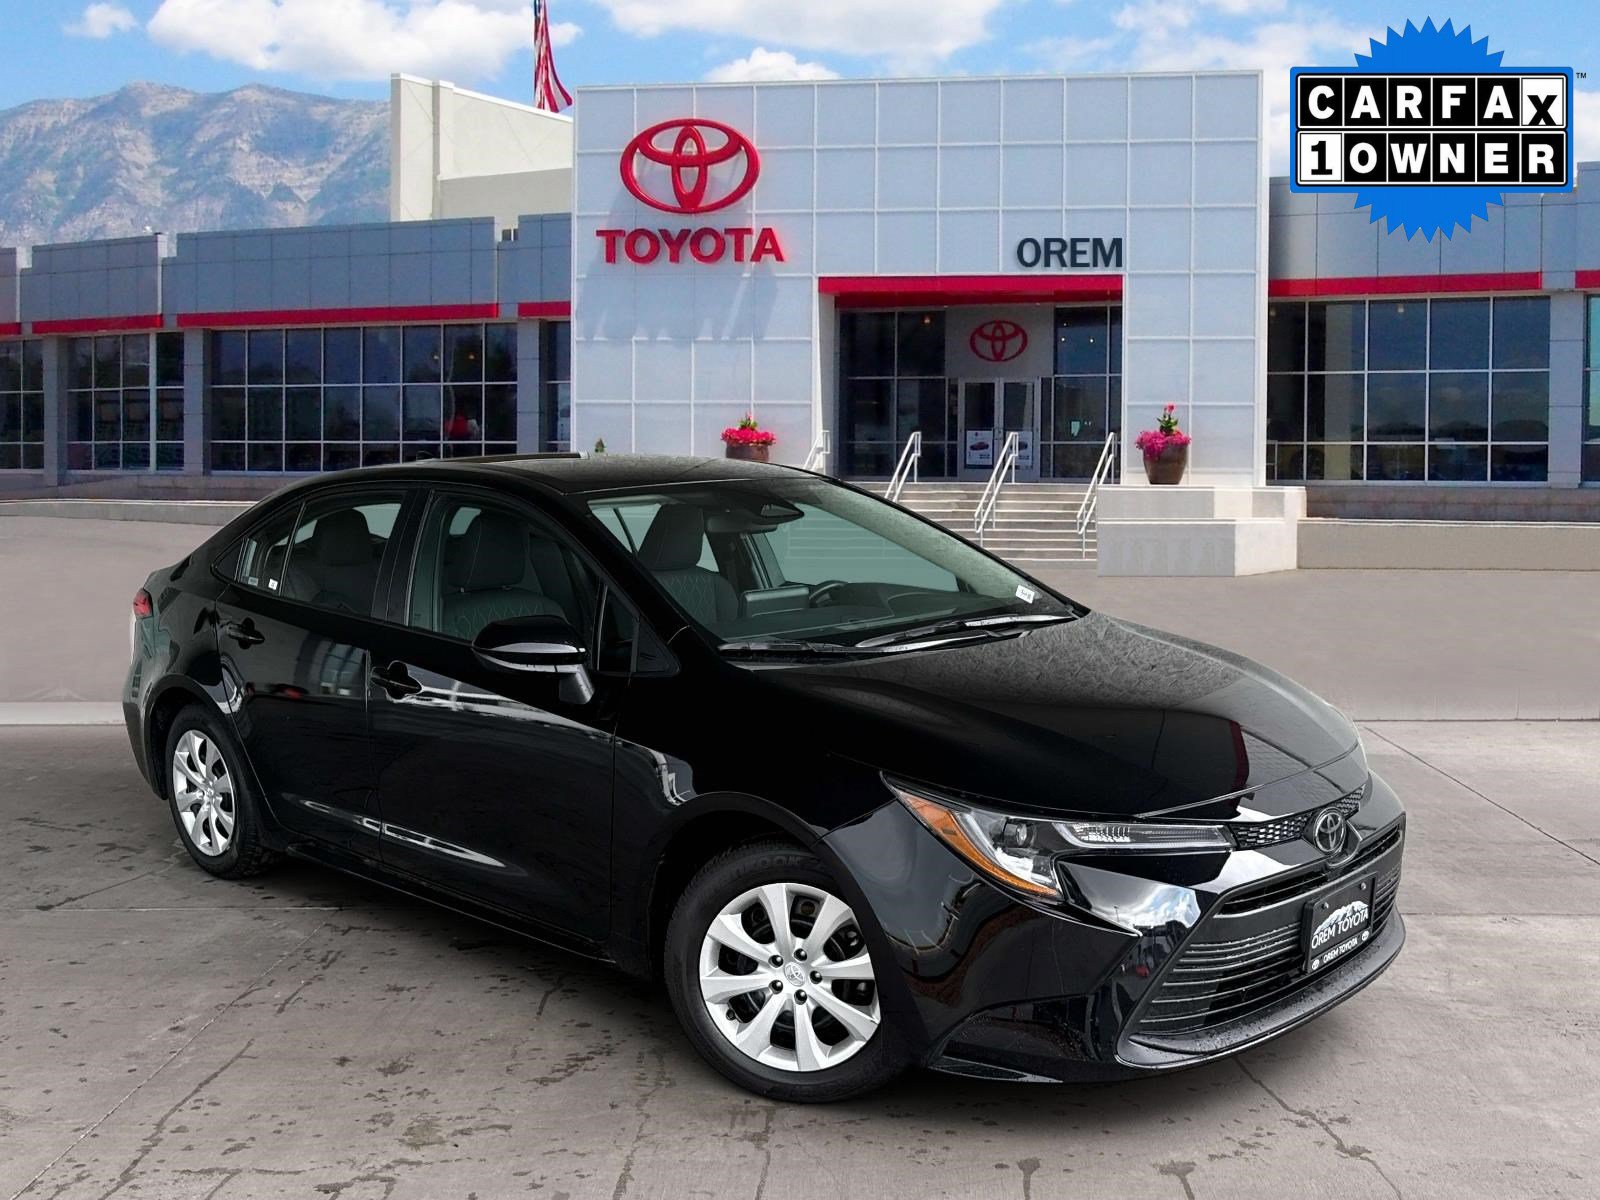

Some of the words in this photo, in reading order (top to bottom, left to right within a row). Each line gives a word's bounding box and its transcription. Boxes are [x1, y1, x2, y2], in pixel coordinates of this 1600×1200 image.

[596, 227, 785, 264] TOYOTA
[1016, 237, 1123, 268] OREM
[1311, 924, 1336, 949] OREM
[1338, 907, 1369, 935] TOYOTA
[1323, 947, 1339, 963] OREM
